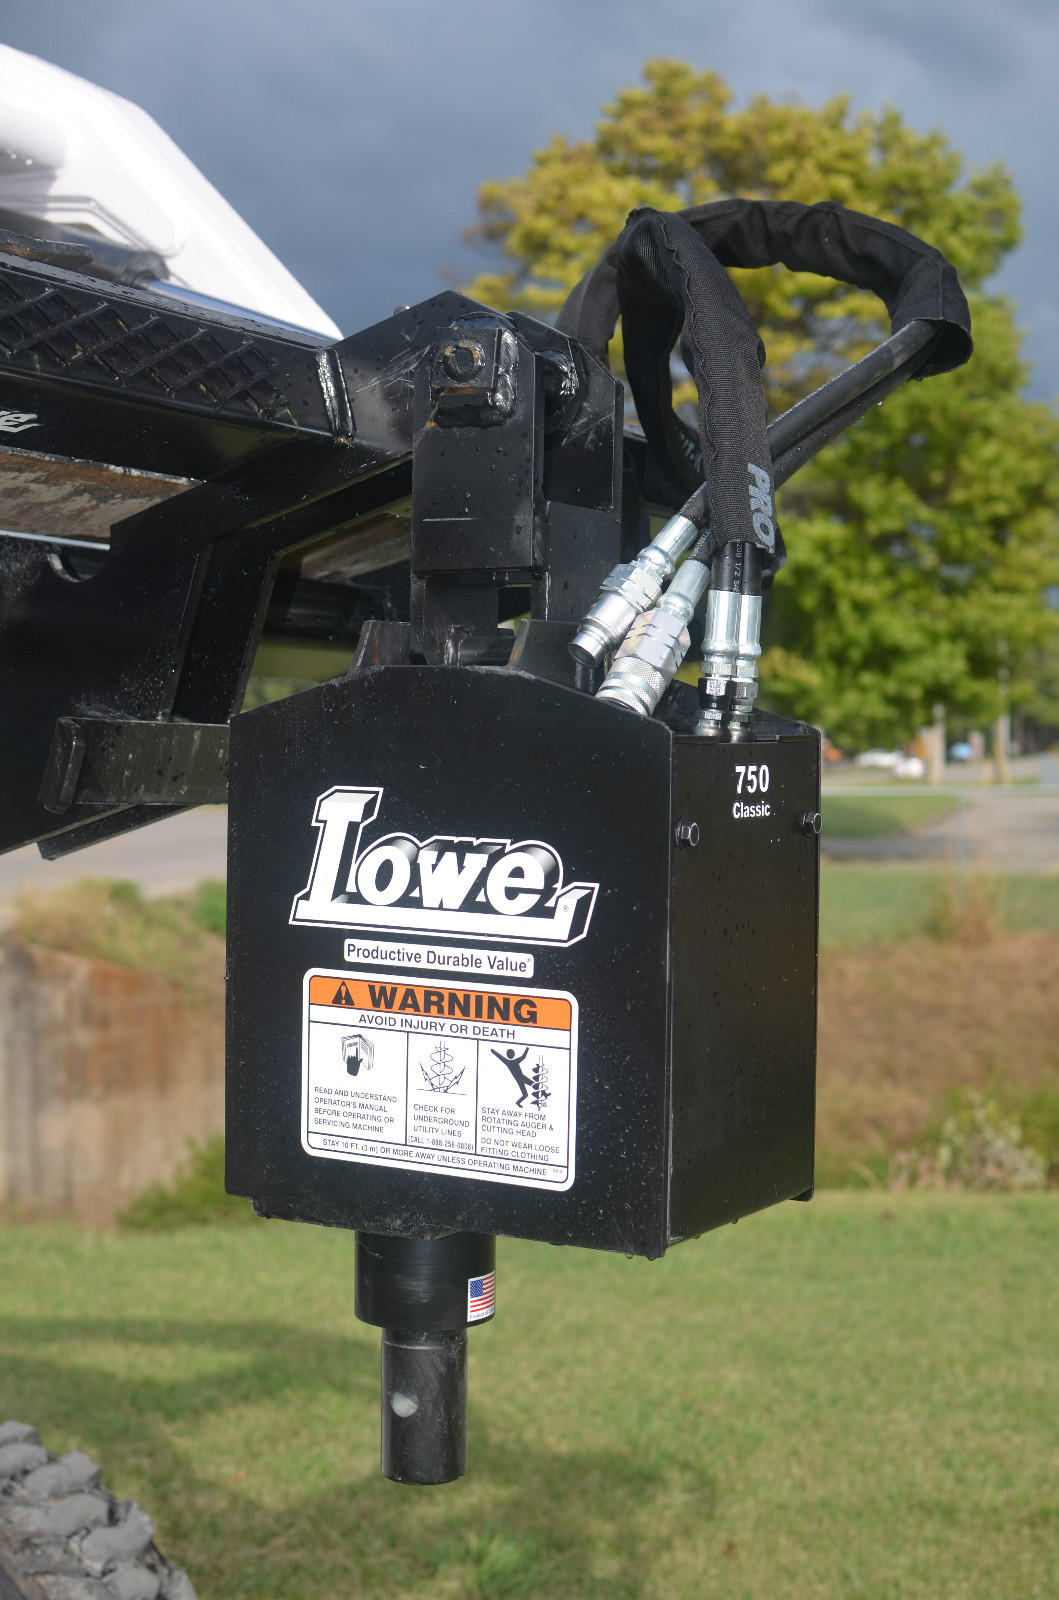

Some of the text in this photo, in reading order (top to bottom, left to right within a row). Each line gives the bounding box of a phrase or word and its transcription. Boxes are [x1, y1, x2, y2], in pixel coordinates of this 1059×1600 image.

[747, 462, 776, 554] PRO
[735, 764, 770, 794] 750
[732, 800, 771, 819] Classic
[289, 786, 599, 947] Lowe
[347, 943, 422, 963] Productive
[426, 950, 483, 969] Durable
[367, 984, 538, 1025] WARNING
[358, 1014, 516, 1039] AVOID INJURY OR DEATH
[314, 1086, 398, 1103] READ AND UNDERSTAND
[314, 1096, 388, 1113] OPERATOR'S MANUAL
[413, 1103, 438, 1113] CHECK
[314, 1107, 395, 1124] BEFORE OPERATING OR
[413, 1114, 470, 1128] UNDERGROUND
[481, 1106, 547, 1121] STAY AWAY FROM
[313, 1117, 384, 1133] SERVICING MACHINE
[413, 1125, 462, 1138] UTILITY LINES
[481, 1115, 519, 1128] ROTATING
[520, 1120, 547, 1131] AUGER
[481, 1124, 537, 1138] CUTTING HEAD
[480, 1137, 560, 1154] DO NOT WEAR LOOSE
[480, 1146, 549, 1162] FITTING CLOTHING
[322, 1138, 340, 1147] STAY
[341, 1141, 349, 1149] 10
[380, 1146, 391, 1154] OR
[392, 1148, 413, 1158] MORE
[415, 1151, 435, 1160] AWAY
[437, 1155, 466, 1165] UNLESS
[467, 1159, 510, 1171] OPERATING
[512, 1165, 547, 1176] MACHINE
